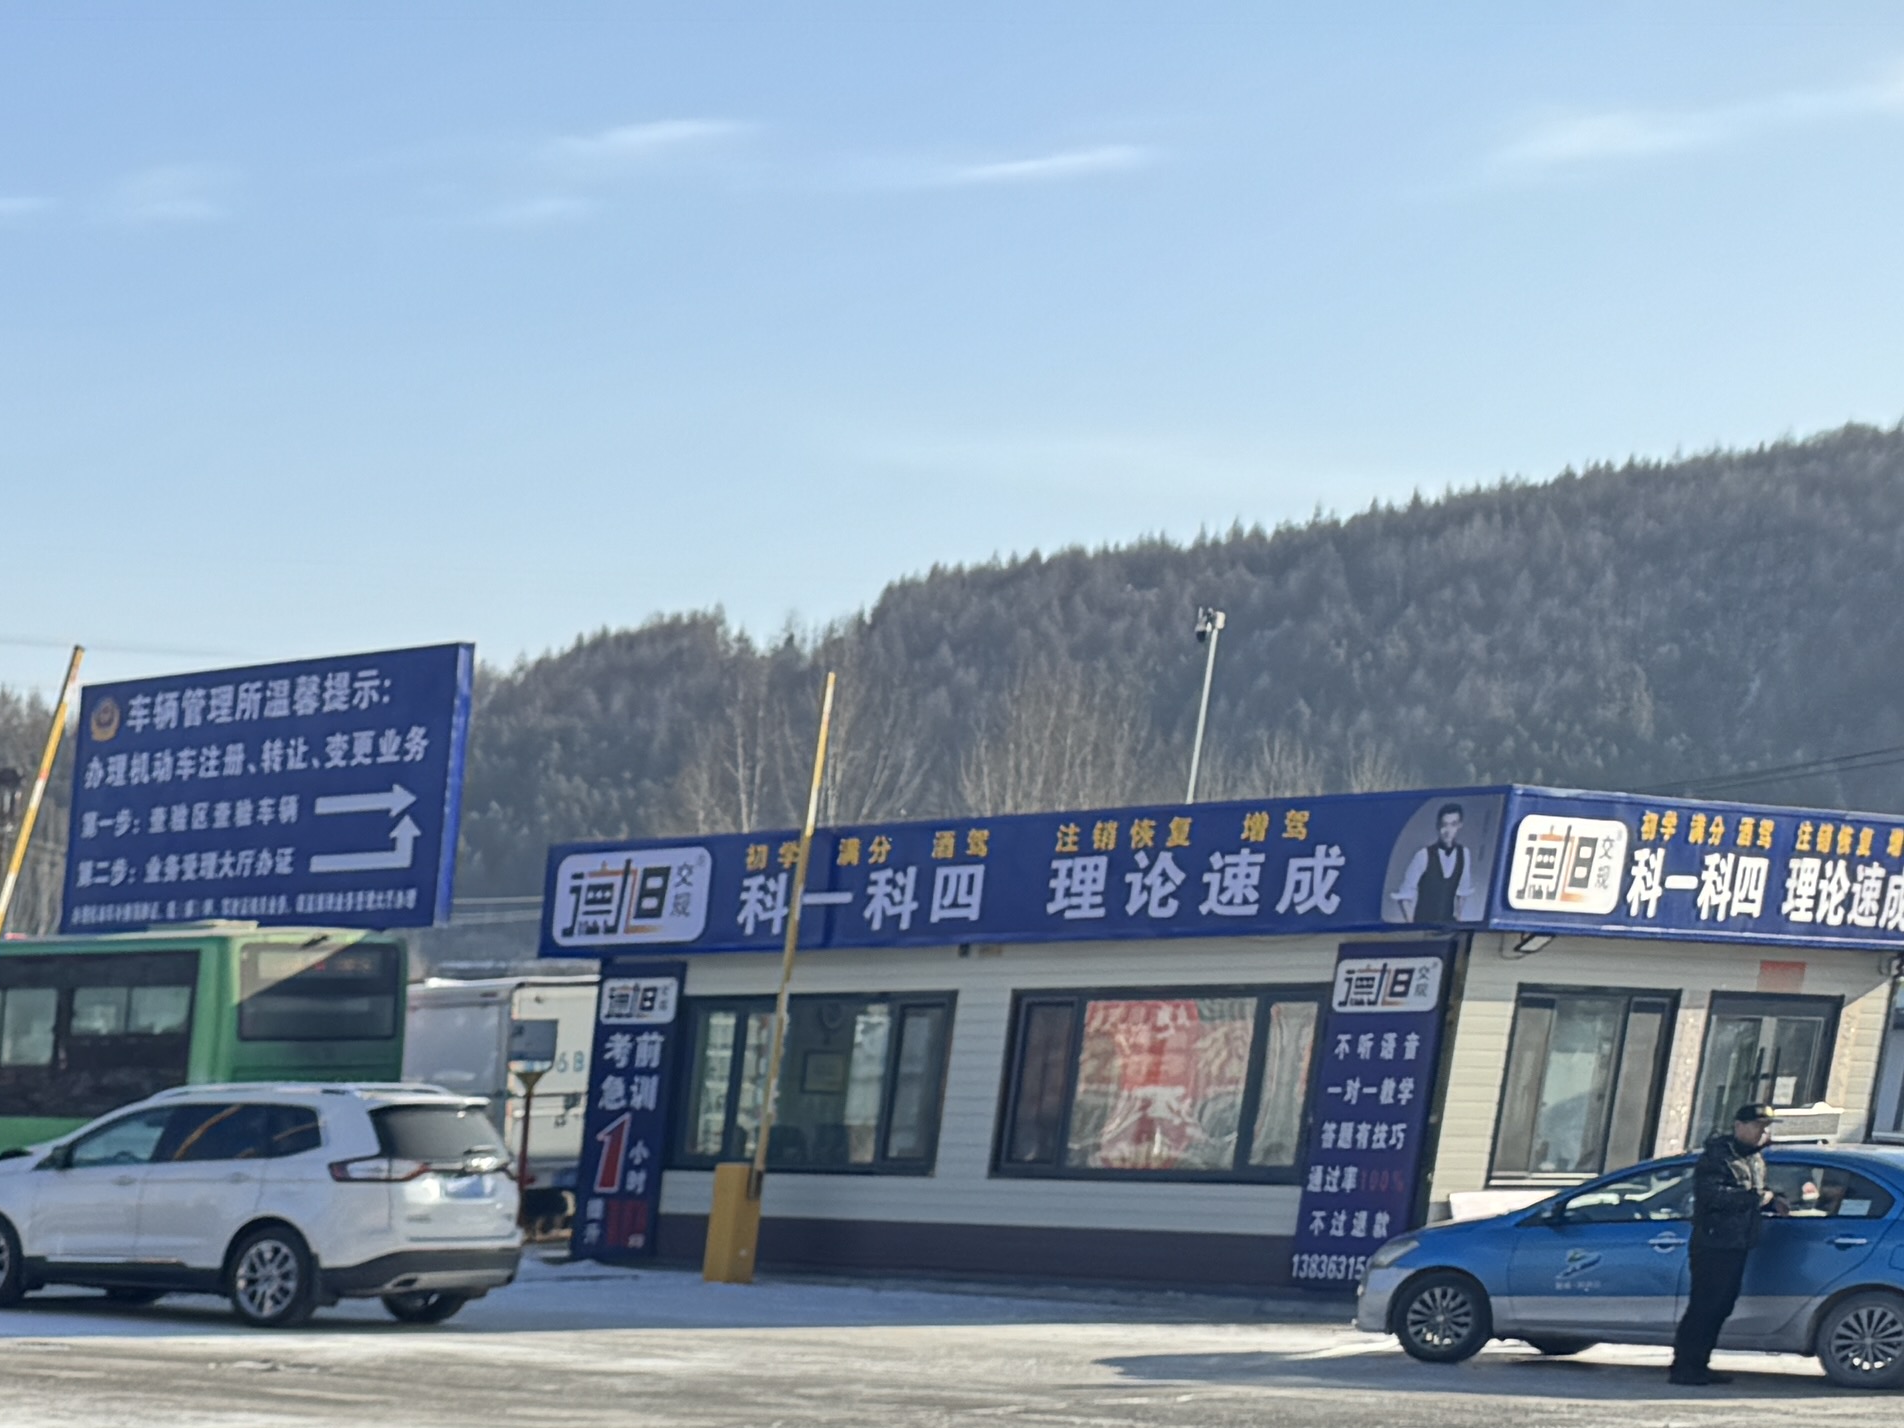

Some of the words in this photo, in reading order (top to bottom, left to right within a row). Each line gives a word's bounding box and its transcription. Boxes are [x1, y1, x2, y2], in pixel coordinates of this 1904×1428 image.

[84, 725, 429, 789] 办理机动车注册、转让、变更业务
[746, 840, 801, 870] 初学
[837, 835, 892, 866] 满分
[931, 828, 990, 859] 酒驾
[1055, 817, 1192, 852] 注销恢复
[1241, 808, 1310, 843] 增驾
[736, 864, 985, 937] 科一科四
[1046, 844, 1347, 920] 理论速成
[1626, 847, 1770, 923] 科一科四
[603, 1031, 665, 1070] 考前
[1334, 1031, 1421, 1061] 不听语音
[597, 1074, 661, 1111] 急训
[1327, 1076, 1414, 1106] 一对一教学
[1320, 1120, 1408, 1151] 答题有技巧
[1309, 1209, 1391, 1239] 不过退款
